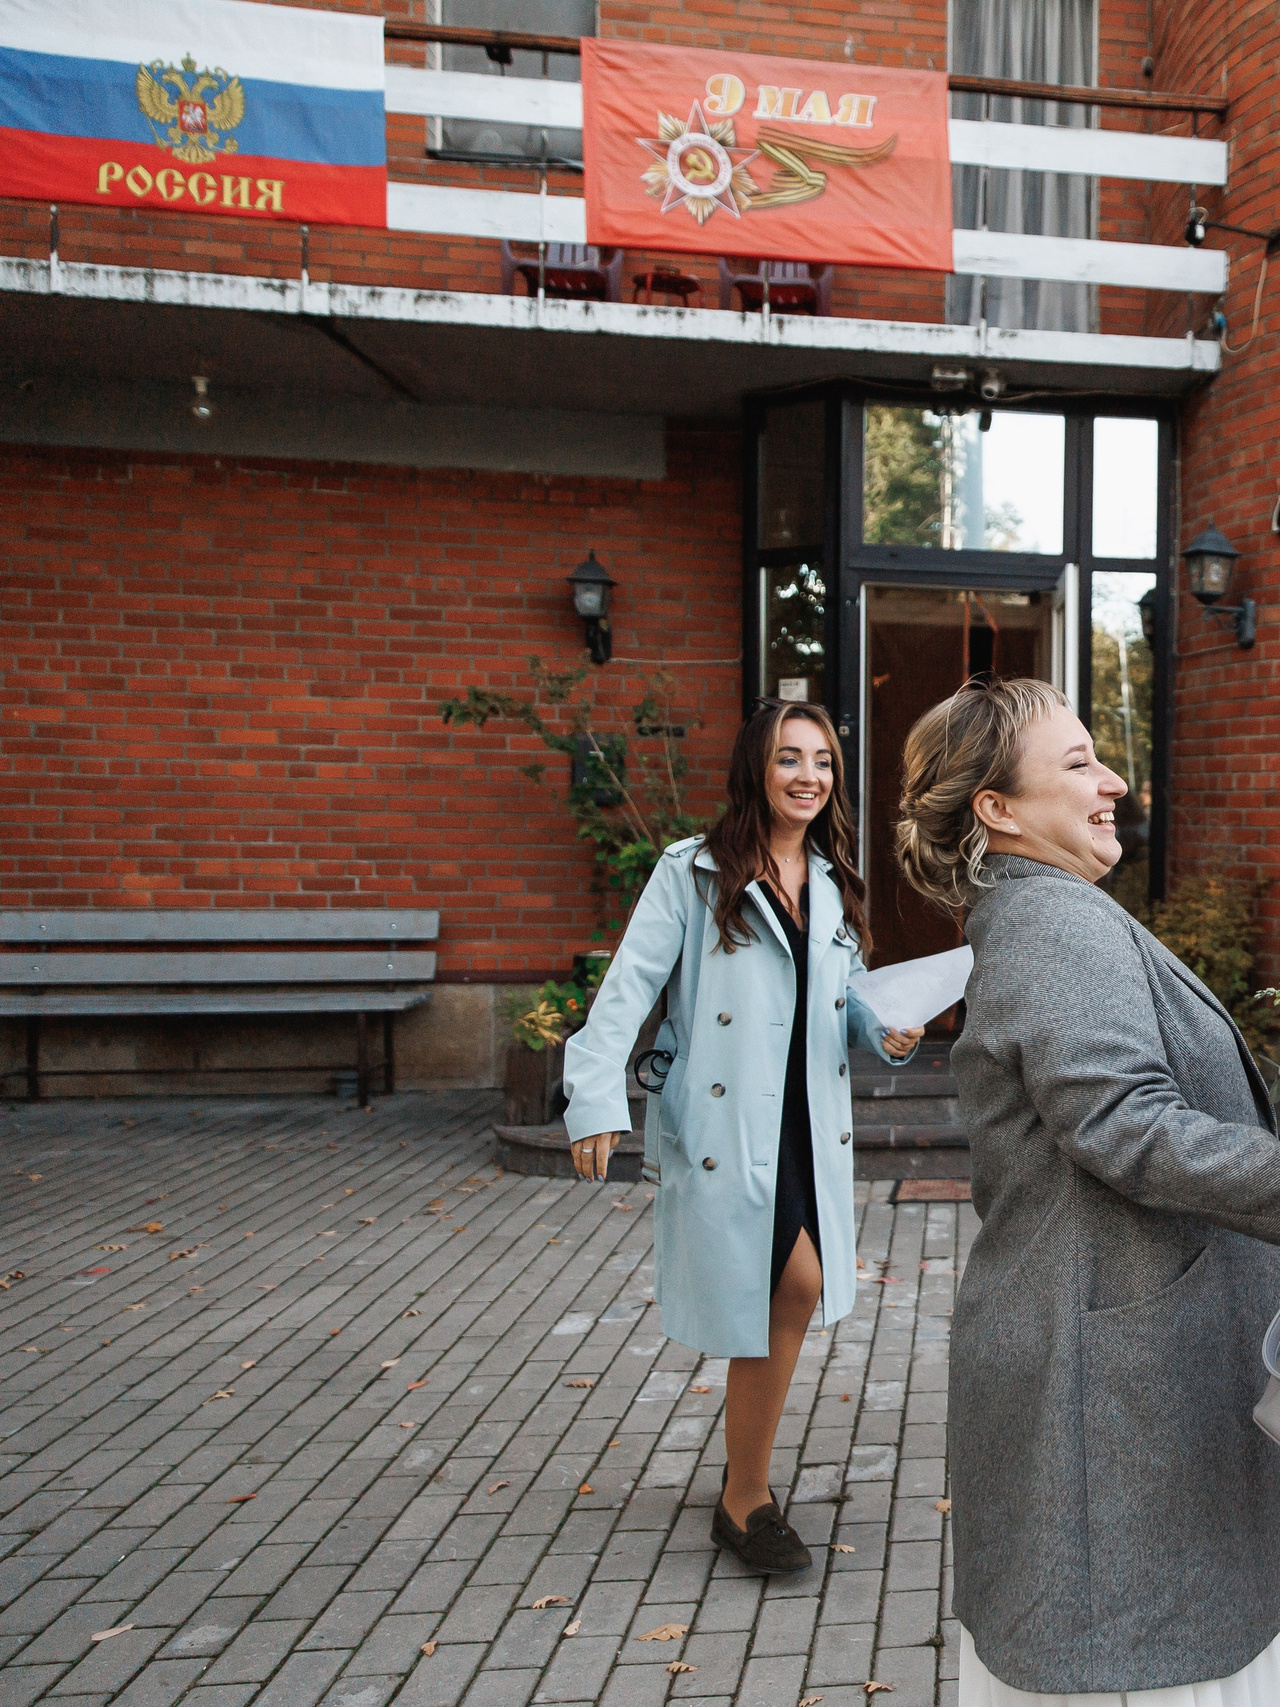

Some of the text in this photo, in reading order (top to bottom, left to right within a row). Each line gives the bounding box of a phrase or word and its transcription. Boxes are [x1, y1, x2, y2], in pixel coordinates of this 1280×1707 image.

[703, 73, 877, 128] 9 МАЯ
[95, 161, 286, 212] РОССИЯ
